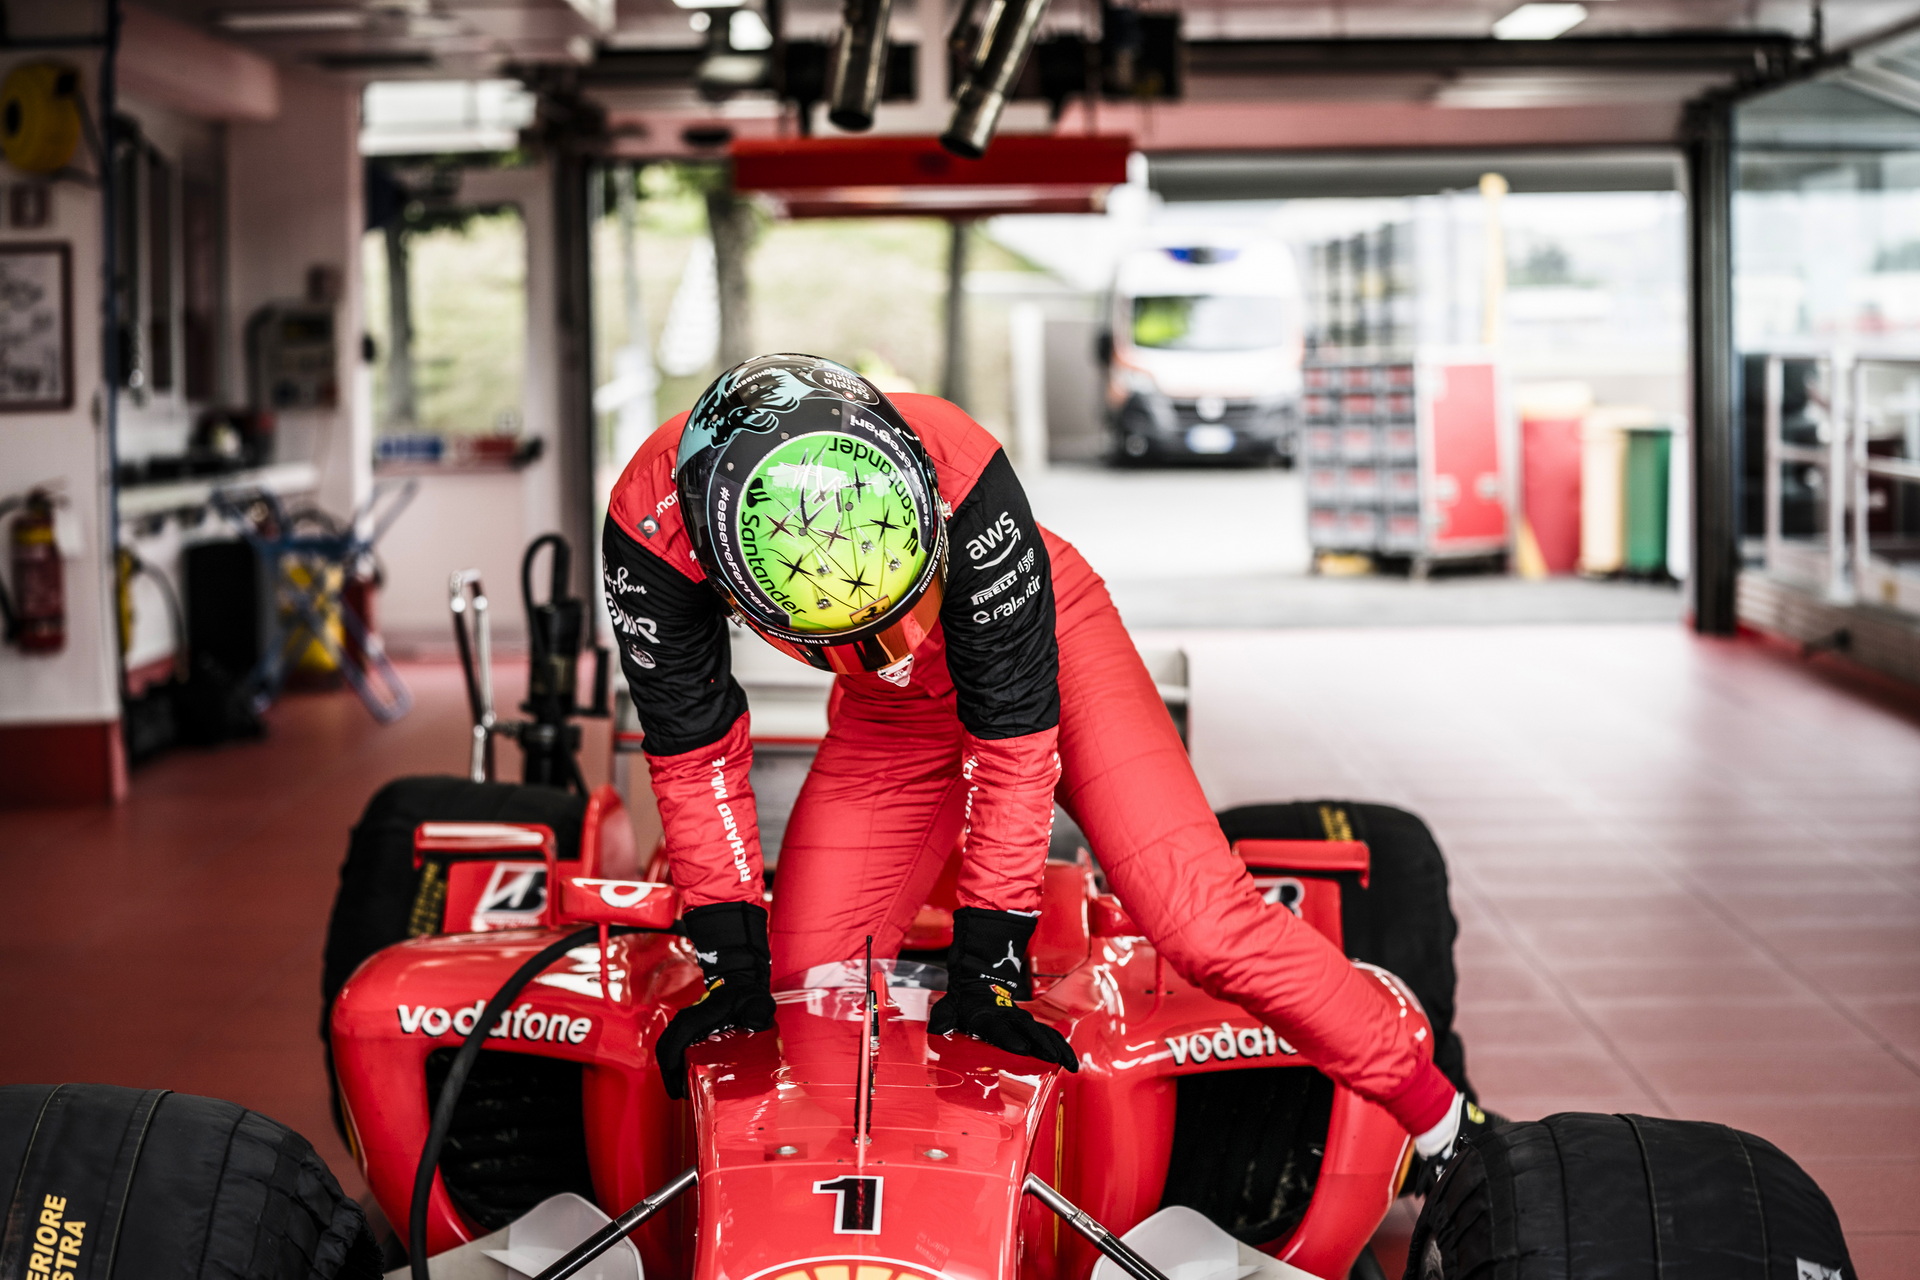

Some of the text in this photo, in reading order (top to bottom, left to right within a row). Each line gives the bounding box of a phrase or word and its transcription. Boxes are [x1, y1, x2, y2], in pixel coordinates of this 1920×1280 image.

[824, 377, 870, 400] Estrella
[828, 437, 917, 526] Santander
[716, 486, 776, 615] #essereFerrari
[741, 511, 807, 615] Santander
[965, 511, 1015, 560] aws
[970, 569, 1018, 606] PIRELLI
[766, 629, 803, 643] RICHARD
[716, 803, 752, 882] RICHARD
[397, 1000, 592, 1044] vodafone
[812, 1175, 884, 1235] 1
[26, 1194, 68, 1280] ERIORE
